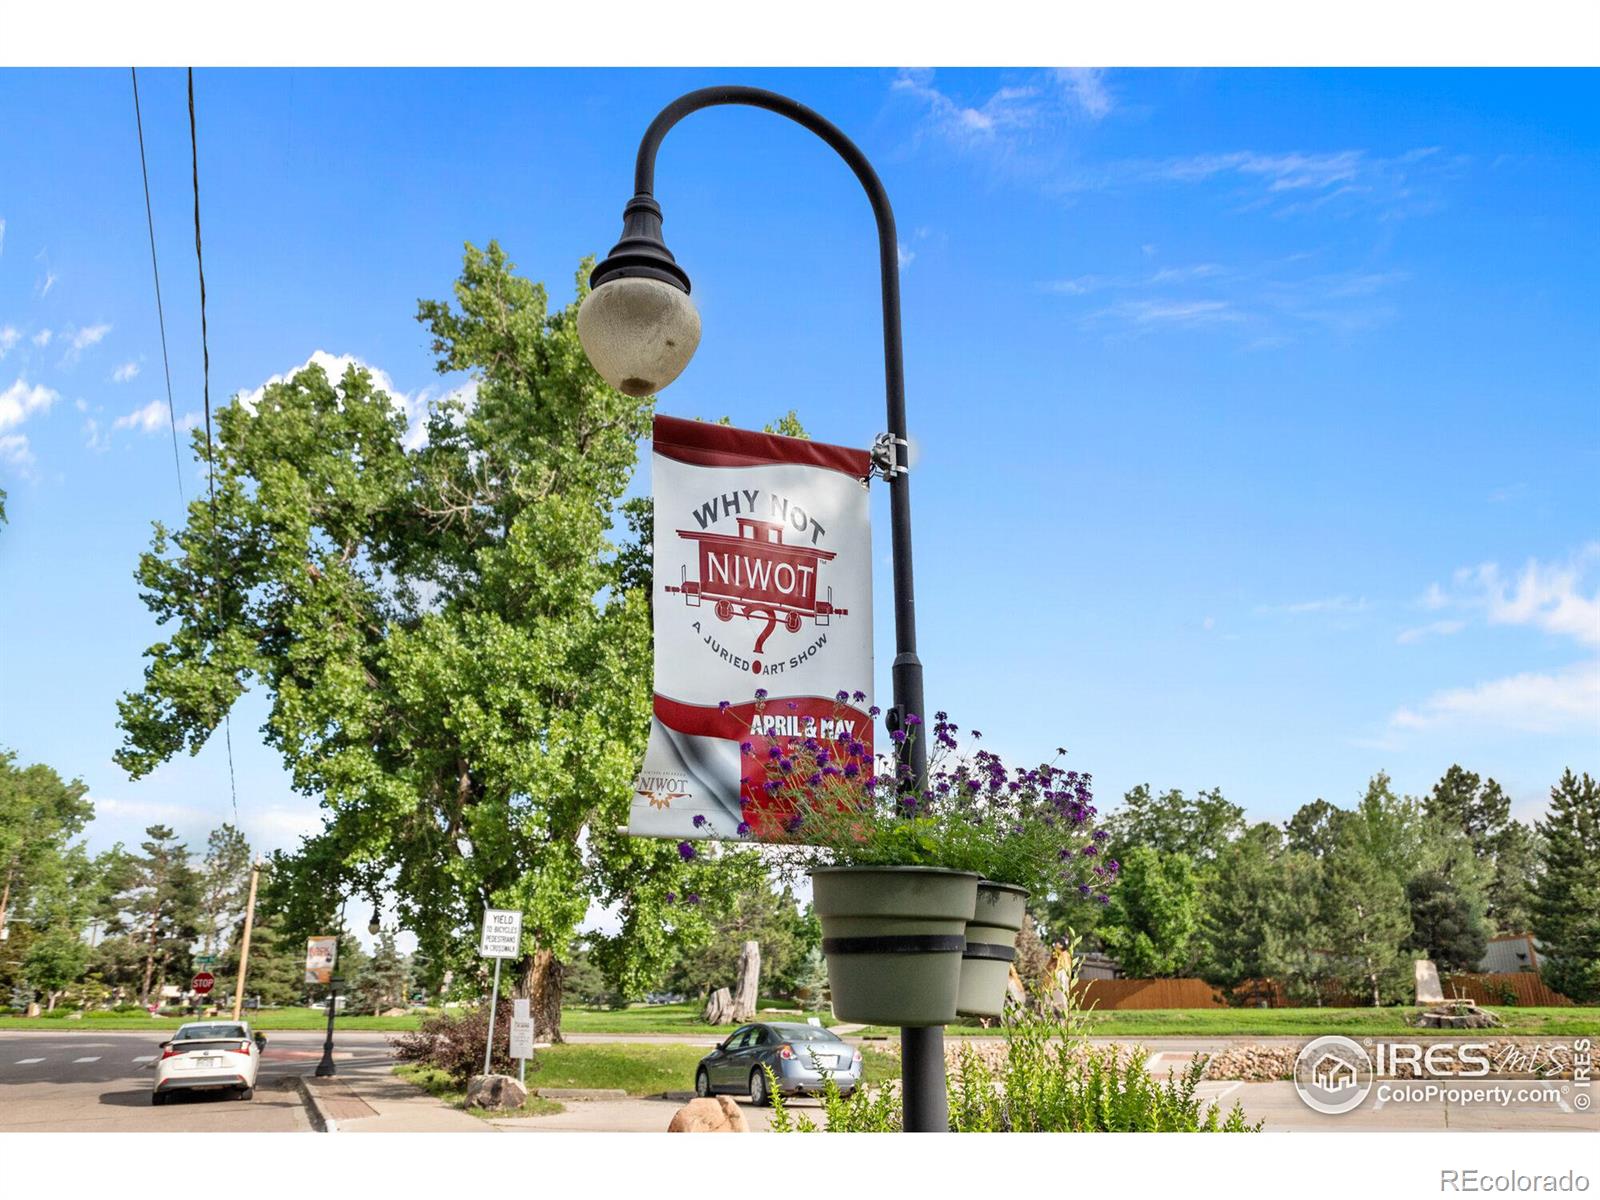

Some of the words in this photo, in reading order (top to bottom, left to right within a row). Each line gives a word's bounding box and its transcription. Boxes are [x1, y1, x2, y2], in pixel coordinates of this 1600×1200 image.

[692, 489, 760, 530] WHY
[769, 493, 826, 545] NOT
[707, 551, 814, 597] NIWOT
[692, 621, 701, 634] A
[703, 635, 750, 672] JURIED
[762, 661, 786, 676] ART
[790, 633, 828, 669] SHOW
[750, 714, 802, 737] APRIL
[638, 777, 688, 793] NIWOT
[493, 914, 514, 925] YIELD
[192, 979, 214, 988] STOP
